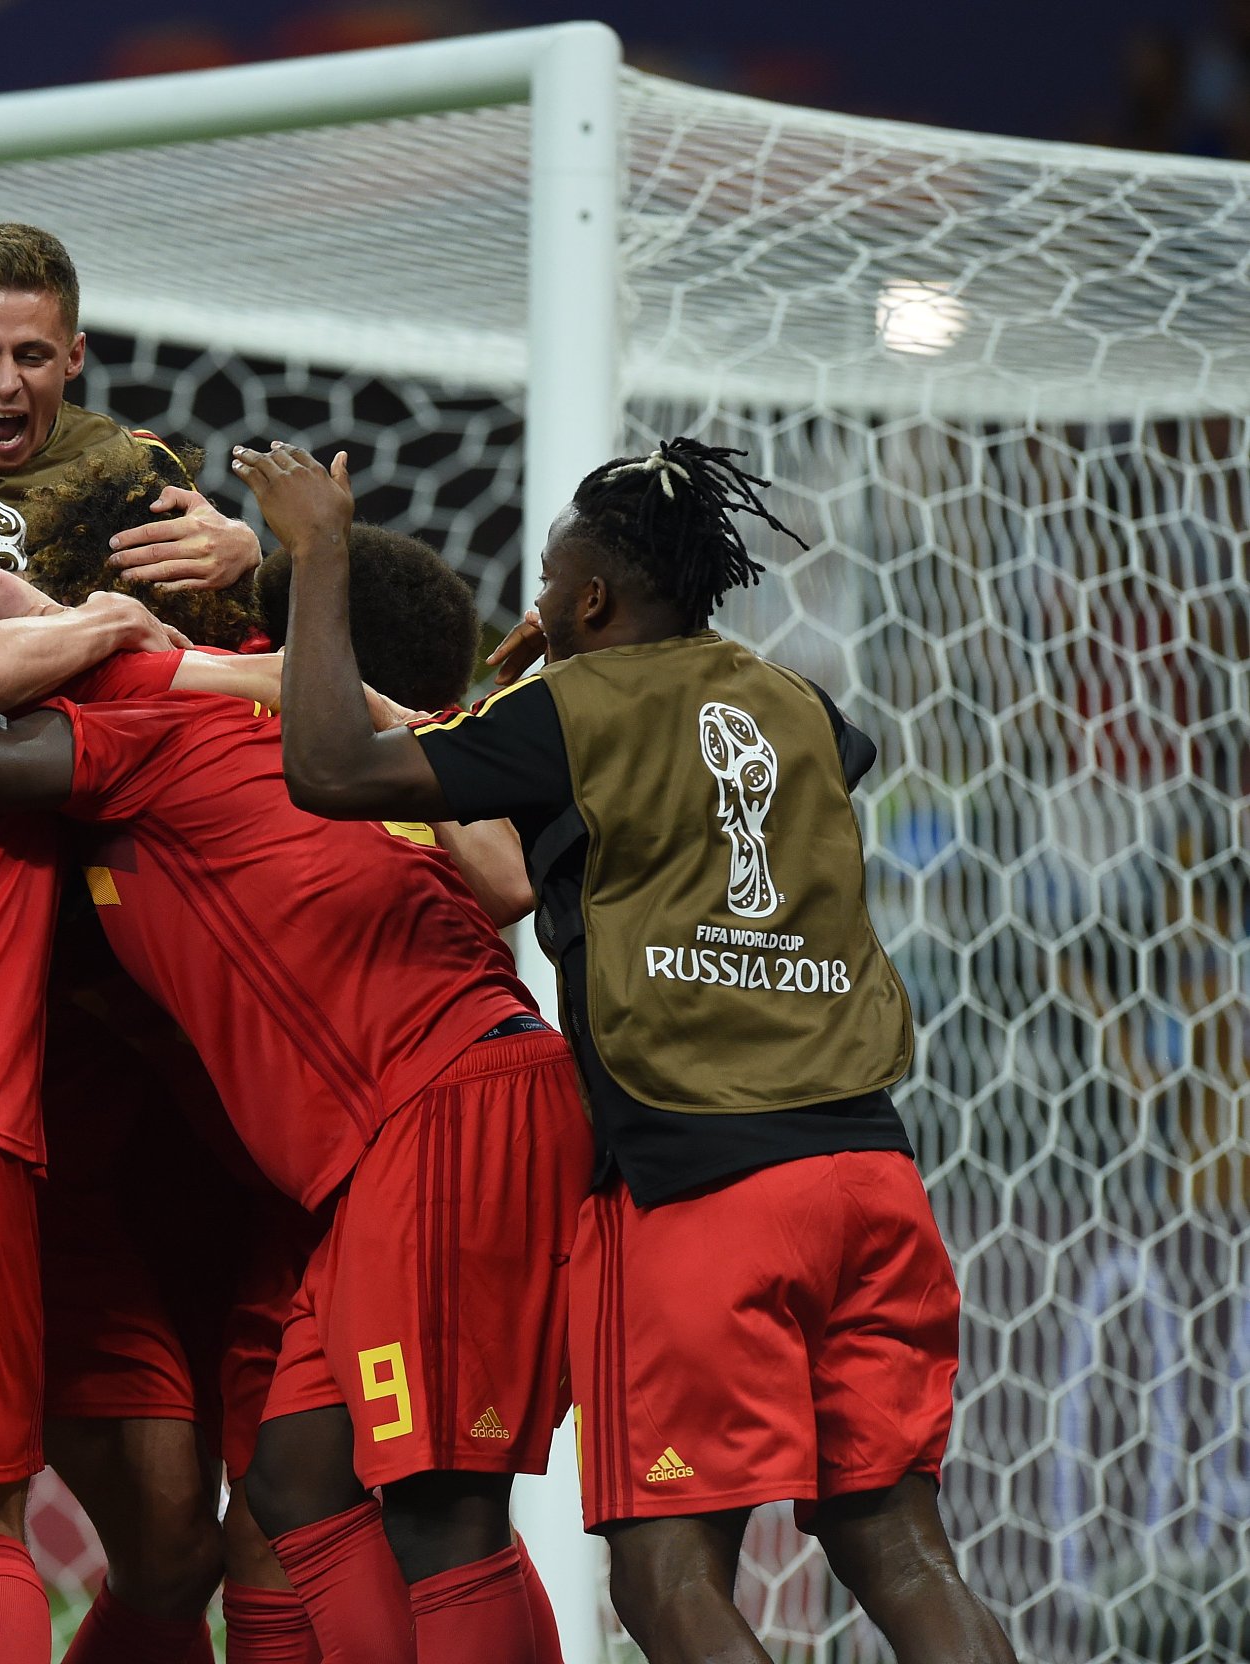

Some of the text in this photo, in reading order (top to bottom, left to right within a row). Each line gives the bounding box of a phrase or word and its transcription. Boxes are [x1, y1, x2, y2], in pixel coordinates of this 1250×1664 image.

[696, 925, 805, 952] FIFA WORLD CUP
[645, 946, 851, 994] RUSSIA 2018
[358, 1341, 413, 1442] 9
[470, 1427, 510, 1440] adidas
[646, 1466, 694, 1482] adidas
